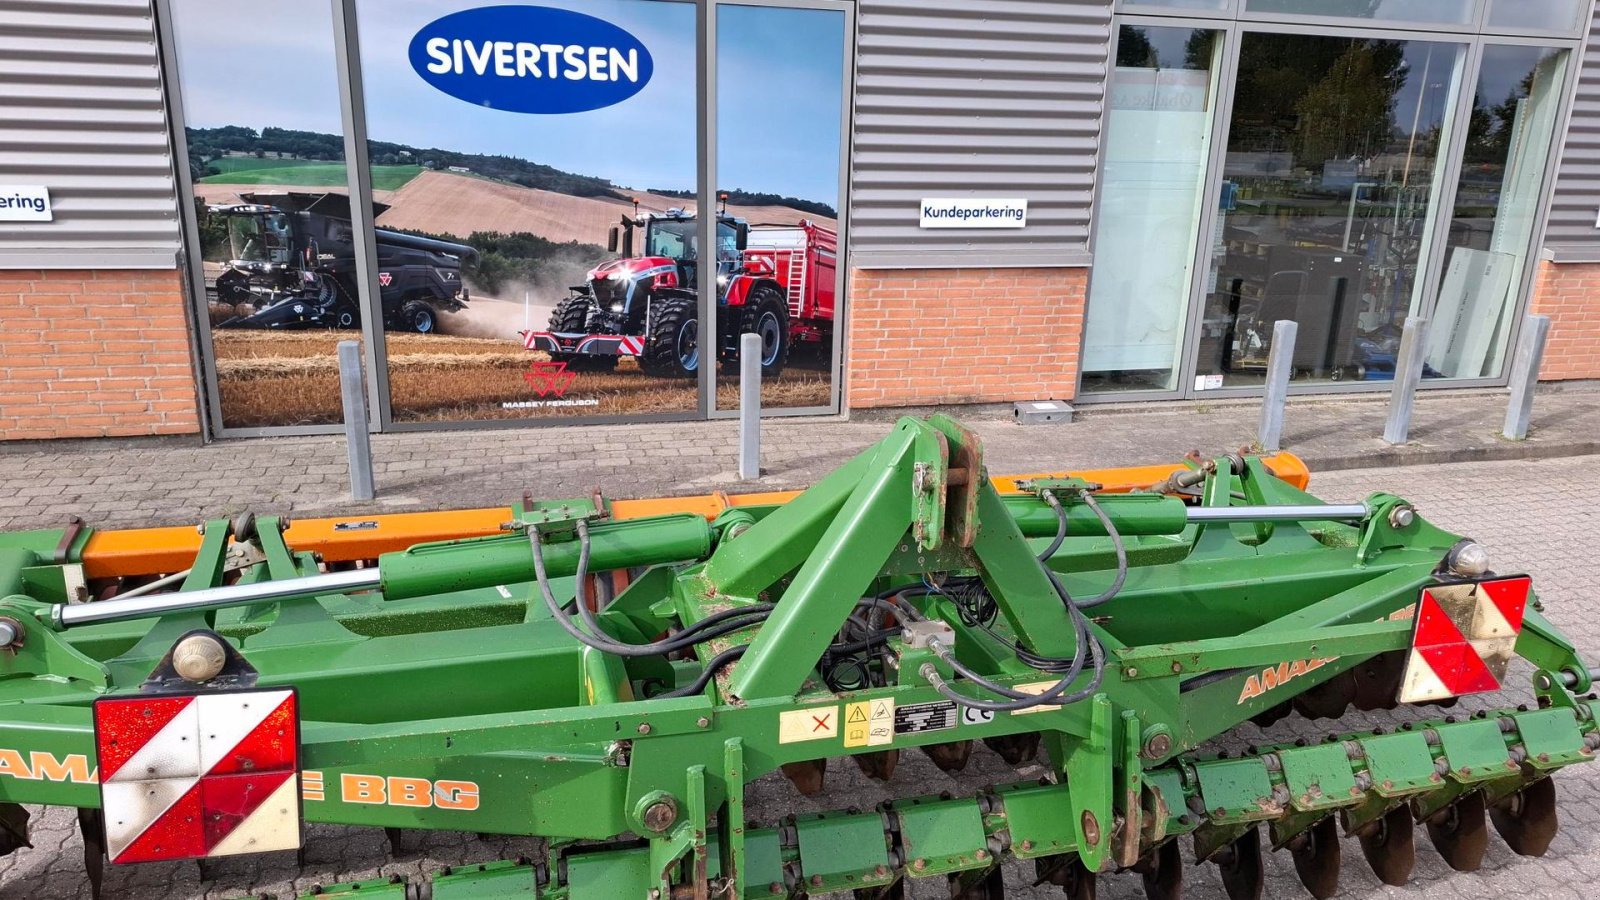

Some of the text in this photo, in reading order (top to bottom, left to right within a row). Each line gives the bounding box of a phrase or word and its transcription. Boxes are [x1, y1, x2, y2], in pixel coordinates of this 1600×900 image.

[426, 37, 638, 83] SIVERTSEN
[0, 193, 46, 212] ering
[924, 205, 1024, 220] Kundeparkering
[546, 399, 599, 407] FERGUSON
[340, 773, 480, 811] BBG
